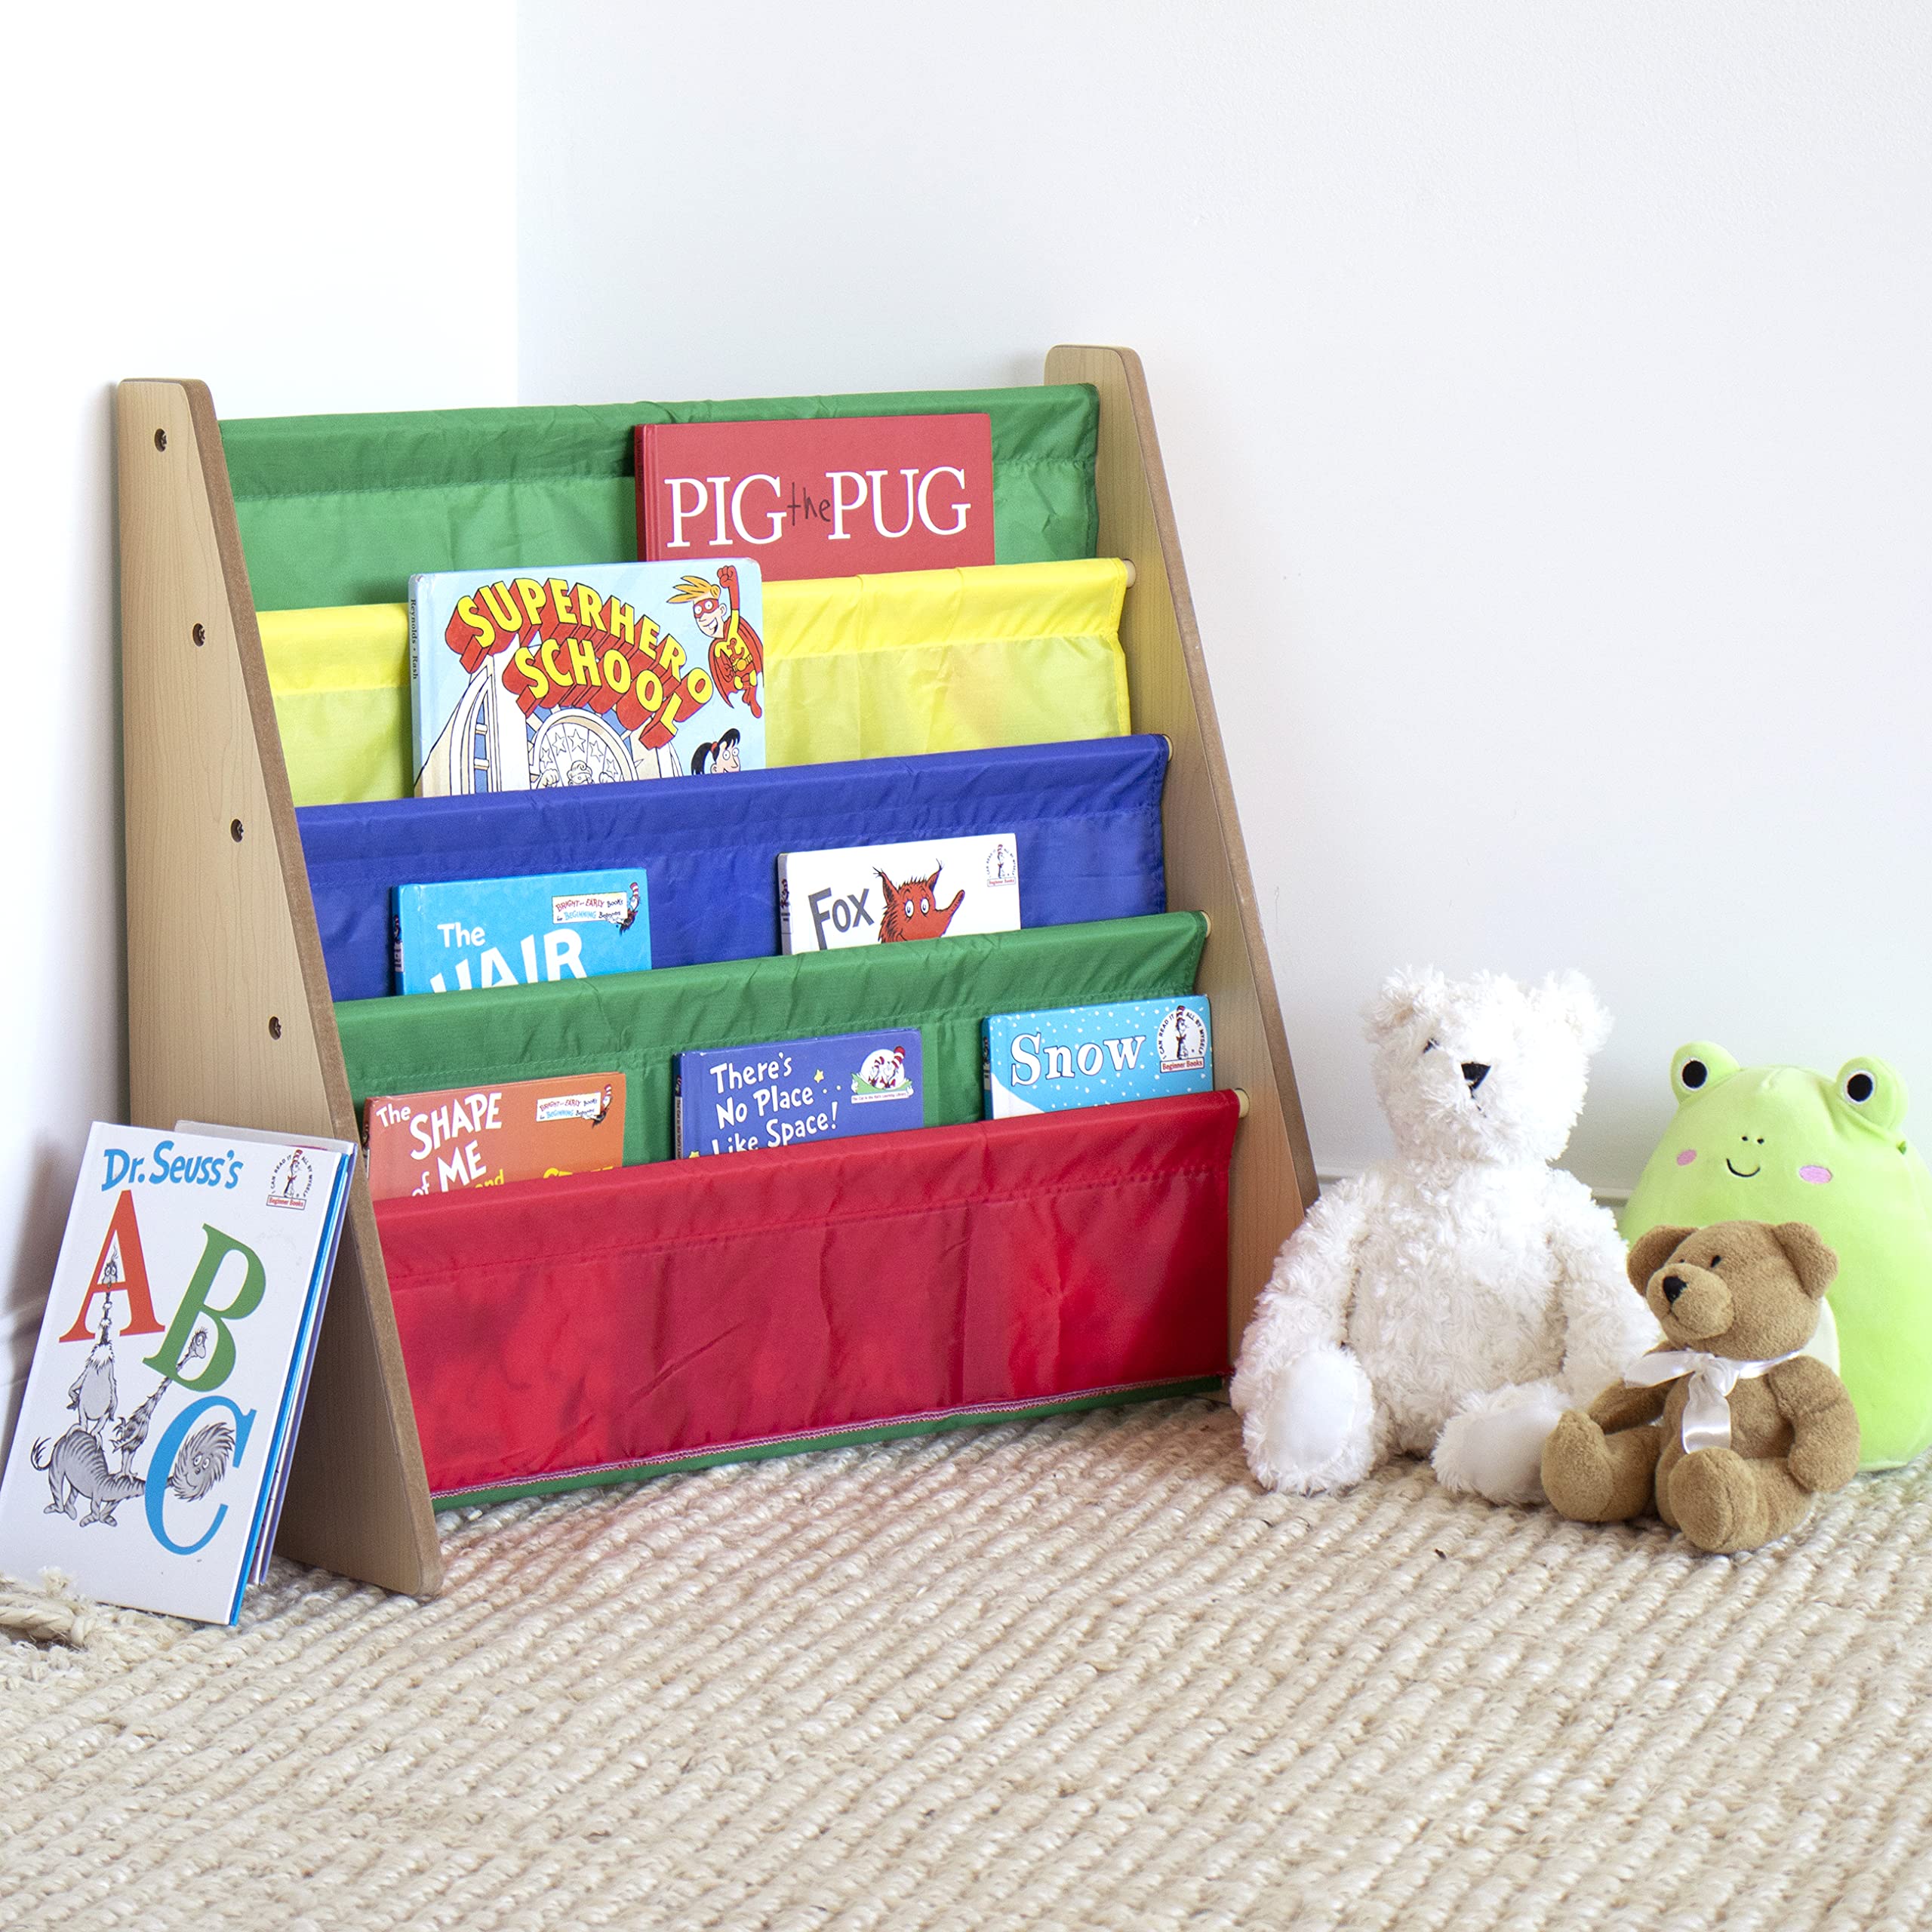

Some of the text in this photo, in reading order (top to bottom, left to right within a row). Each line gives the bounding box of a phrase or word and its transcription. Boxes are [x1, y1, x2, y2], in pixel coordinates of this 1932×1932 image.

[665, 466, 971, 547] PIG the PUG
[451, 577, 714, 715] SUPERHERO
[507, 638, 682, 743] SCHOOL
[437, 921, 486, 948] The
[709, 1052, 792, 1094] There's
[1011, 1032, 1146, 1086] Snow
[376, 1093, 502, 1160] The SHAPE
[716, 1085, 814, 1130] No Place
[766, 1101, 838, 1147] Space!
[101, 1140, 244, 1192] Dr. Seuss's
[438, 1140, 486, 1192] ME
